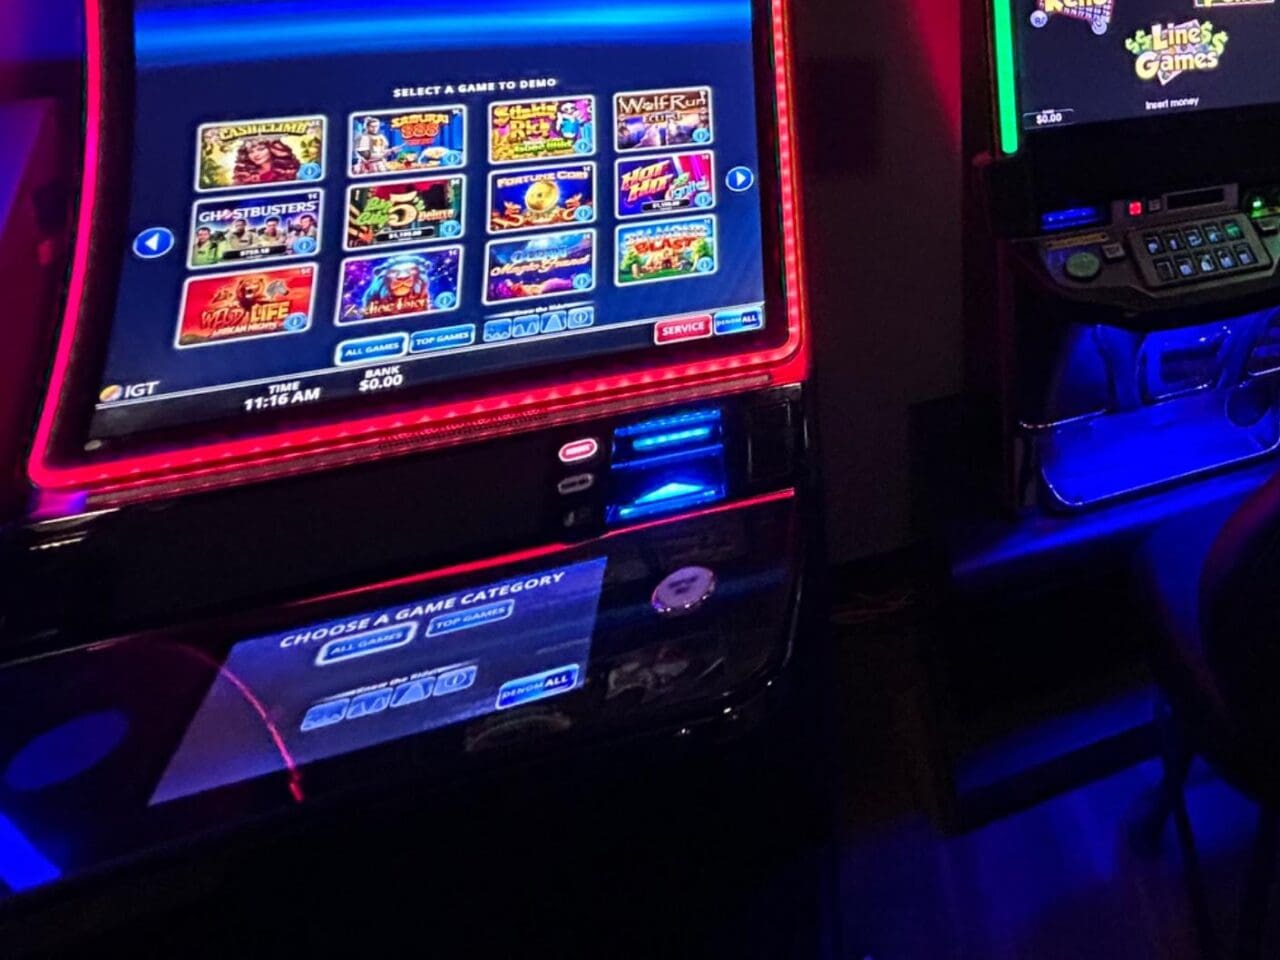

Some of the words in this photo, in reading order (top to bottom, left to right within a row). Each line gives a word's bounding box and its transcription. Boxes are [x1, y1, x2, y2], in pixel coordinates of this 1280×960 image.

[1135, 50, 1218, 79] Games
[393, 86, 440, 98] SELECT
[445, 85, 454, 94] A
[458, 82, 495, 93] GAME
[499, 80, 516, 90] TO
[520, 78, 557, 89] DEMO
[1146, 100, 1168, 110] Insert
[1170, 97, 1199, 109] money
[198, 201, 318, 222] GHOSTBUSTERS
[250, 301, 291, 323] LIFE
[742, 312, 758, 323] ALL
[662, 322, 705, 336] SERVICE
[345, 347, 364, 357] ALL
[365, 342, 400, 353] GAMES
[416, 337, 437, 346] TOP
[439, 332, 470, 343] GAMES
[365, 366, 400, 379] BANK
[124, 381, 160, 399] IGT
[268, 381, 300, 395] TIME
[359, 375, 403, 392] $0.00
[244, 393, 289, 412] 11:16
[291, 387, 321, 404] AM
[280, 619, 373, 649] CHOOSE
[373, 614, 389, 627] A
[395, 597, 457, 622] GAME
[460, 572, 566, 606] CATEGORY
[331, 643, 356, 655] ALL
[357, 632, 403, 649] GAMES
[436, 617, 462, 628] TOP
[463, 606, 506, 623] GAMES
[544, 674, 568, 688] ALL
